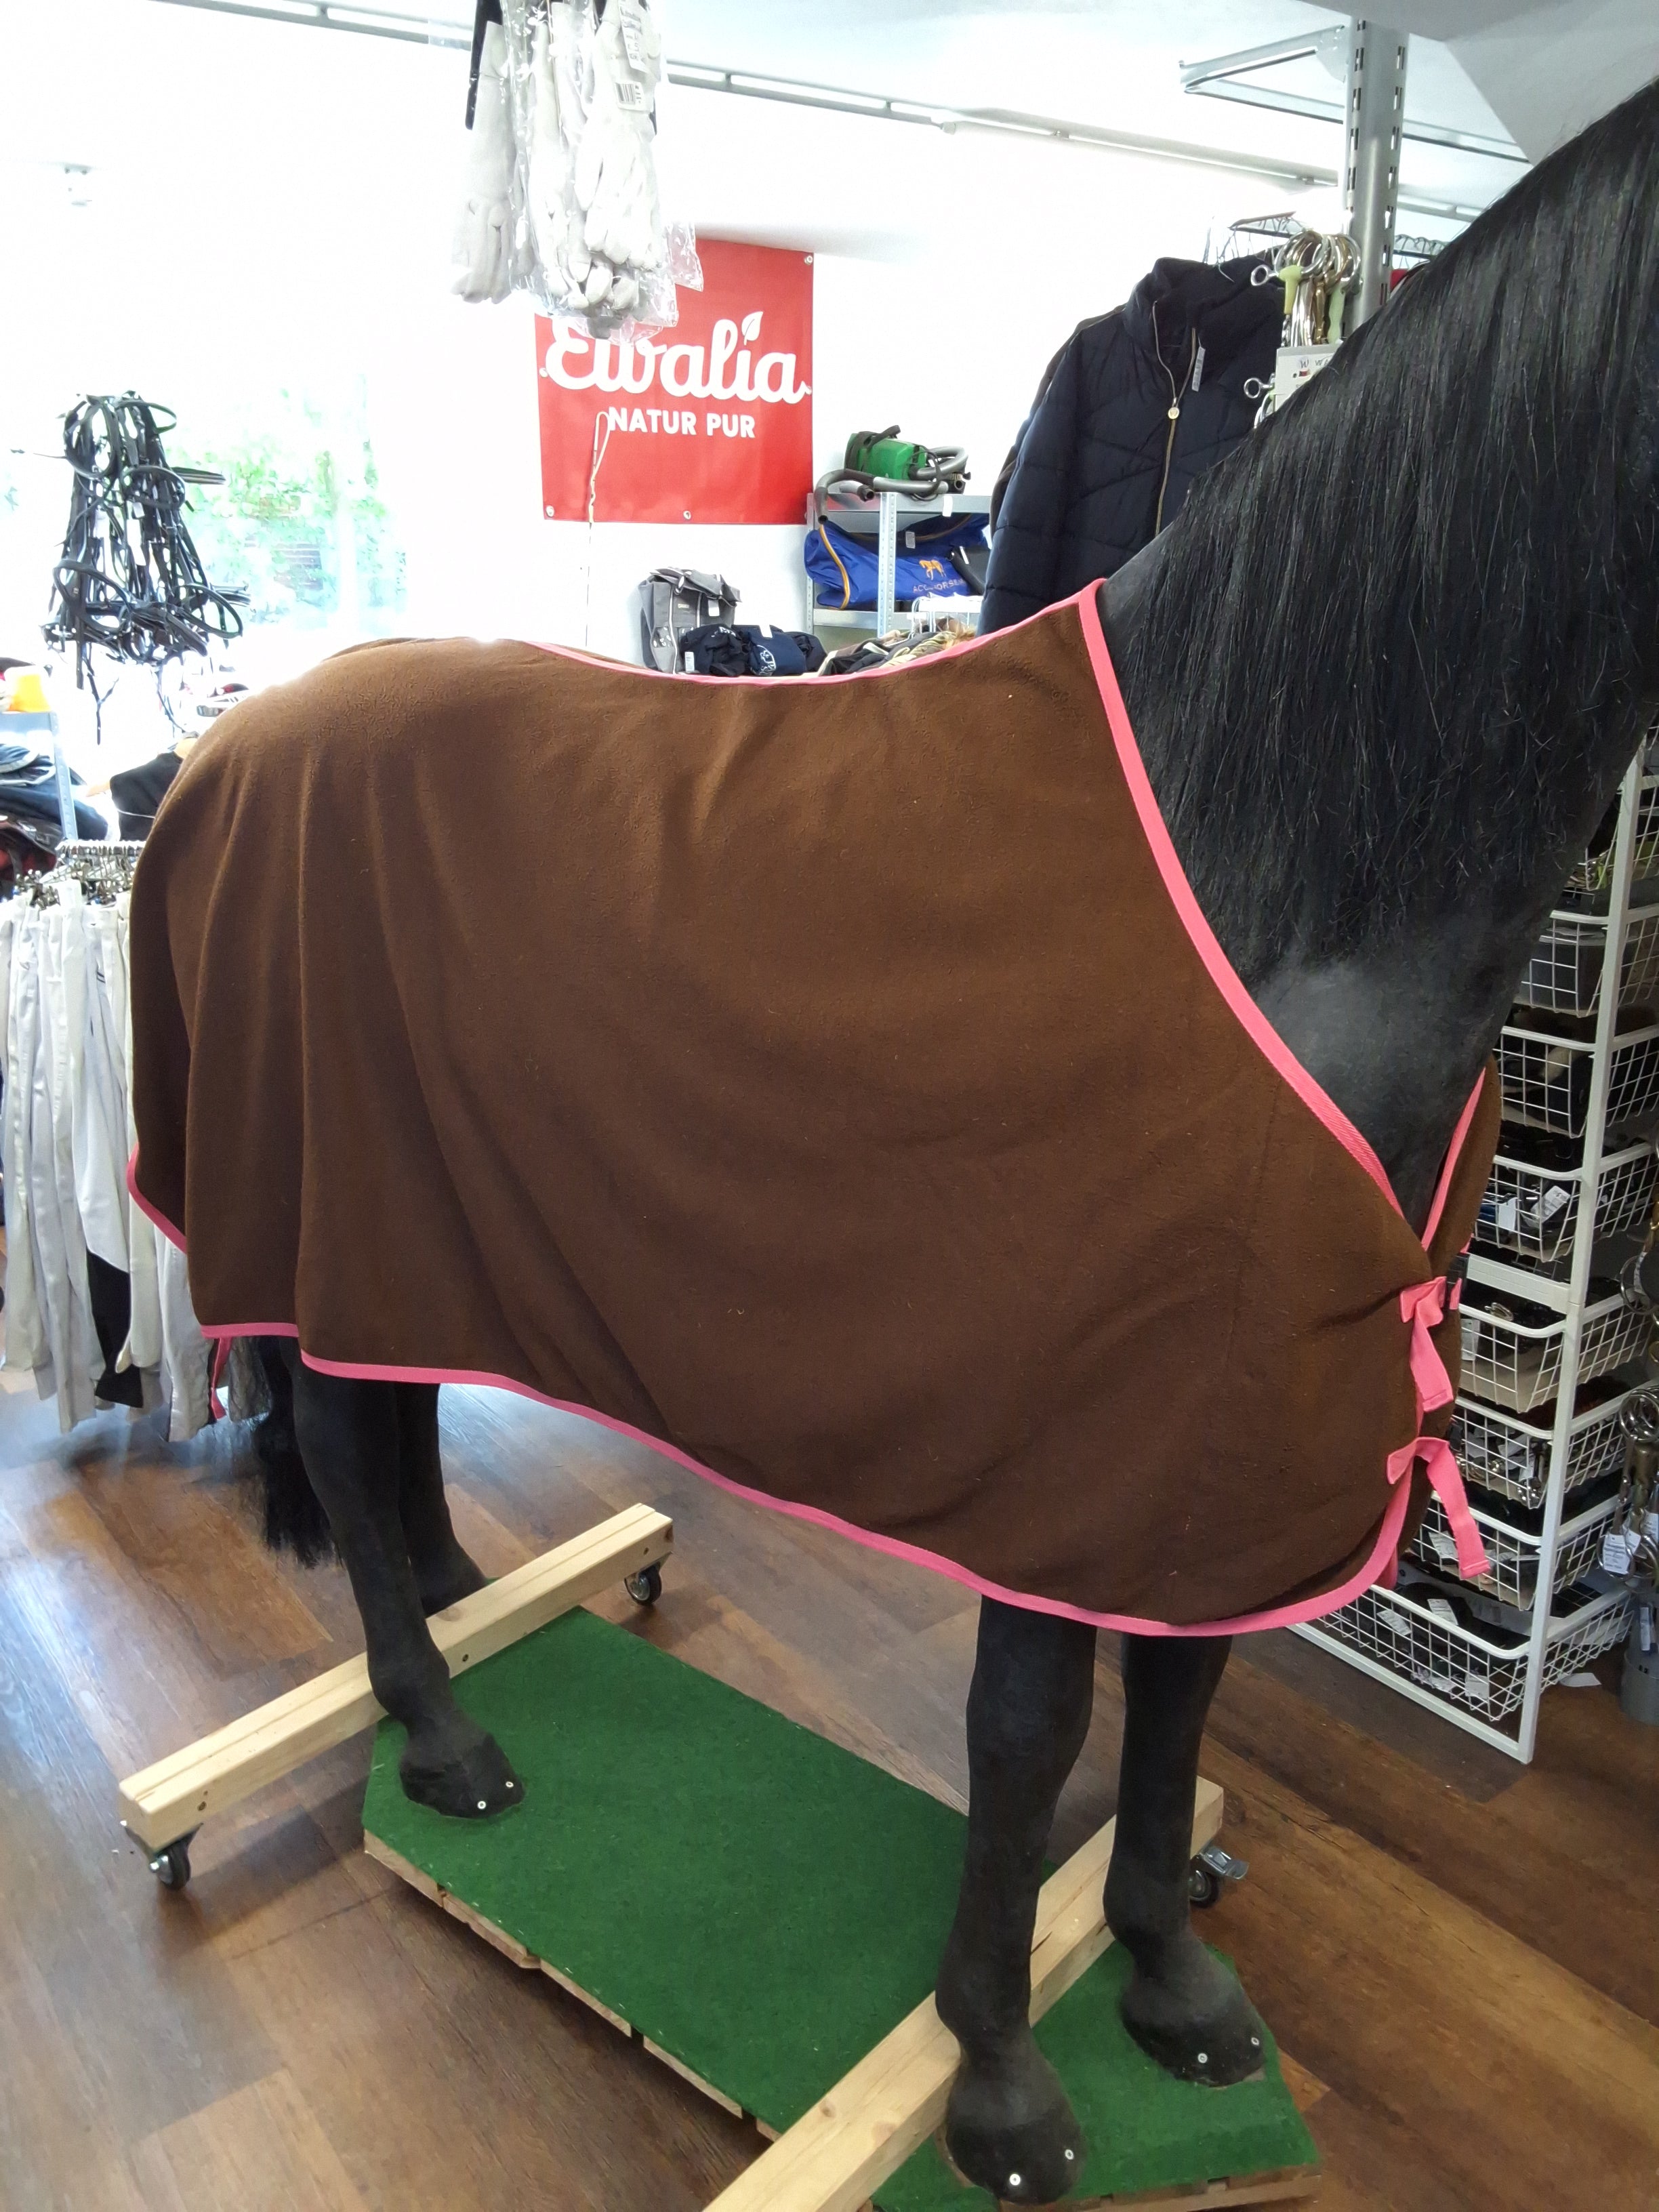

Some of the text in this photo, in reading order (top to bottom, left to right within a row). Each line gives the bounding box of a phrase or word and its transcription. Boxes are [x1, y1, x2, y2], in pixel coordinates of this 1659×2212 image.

[545, 312, 806, 404] Ewalia
[609, 407, 756, 438] NATUR PUR
